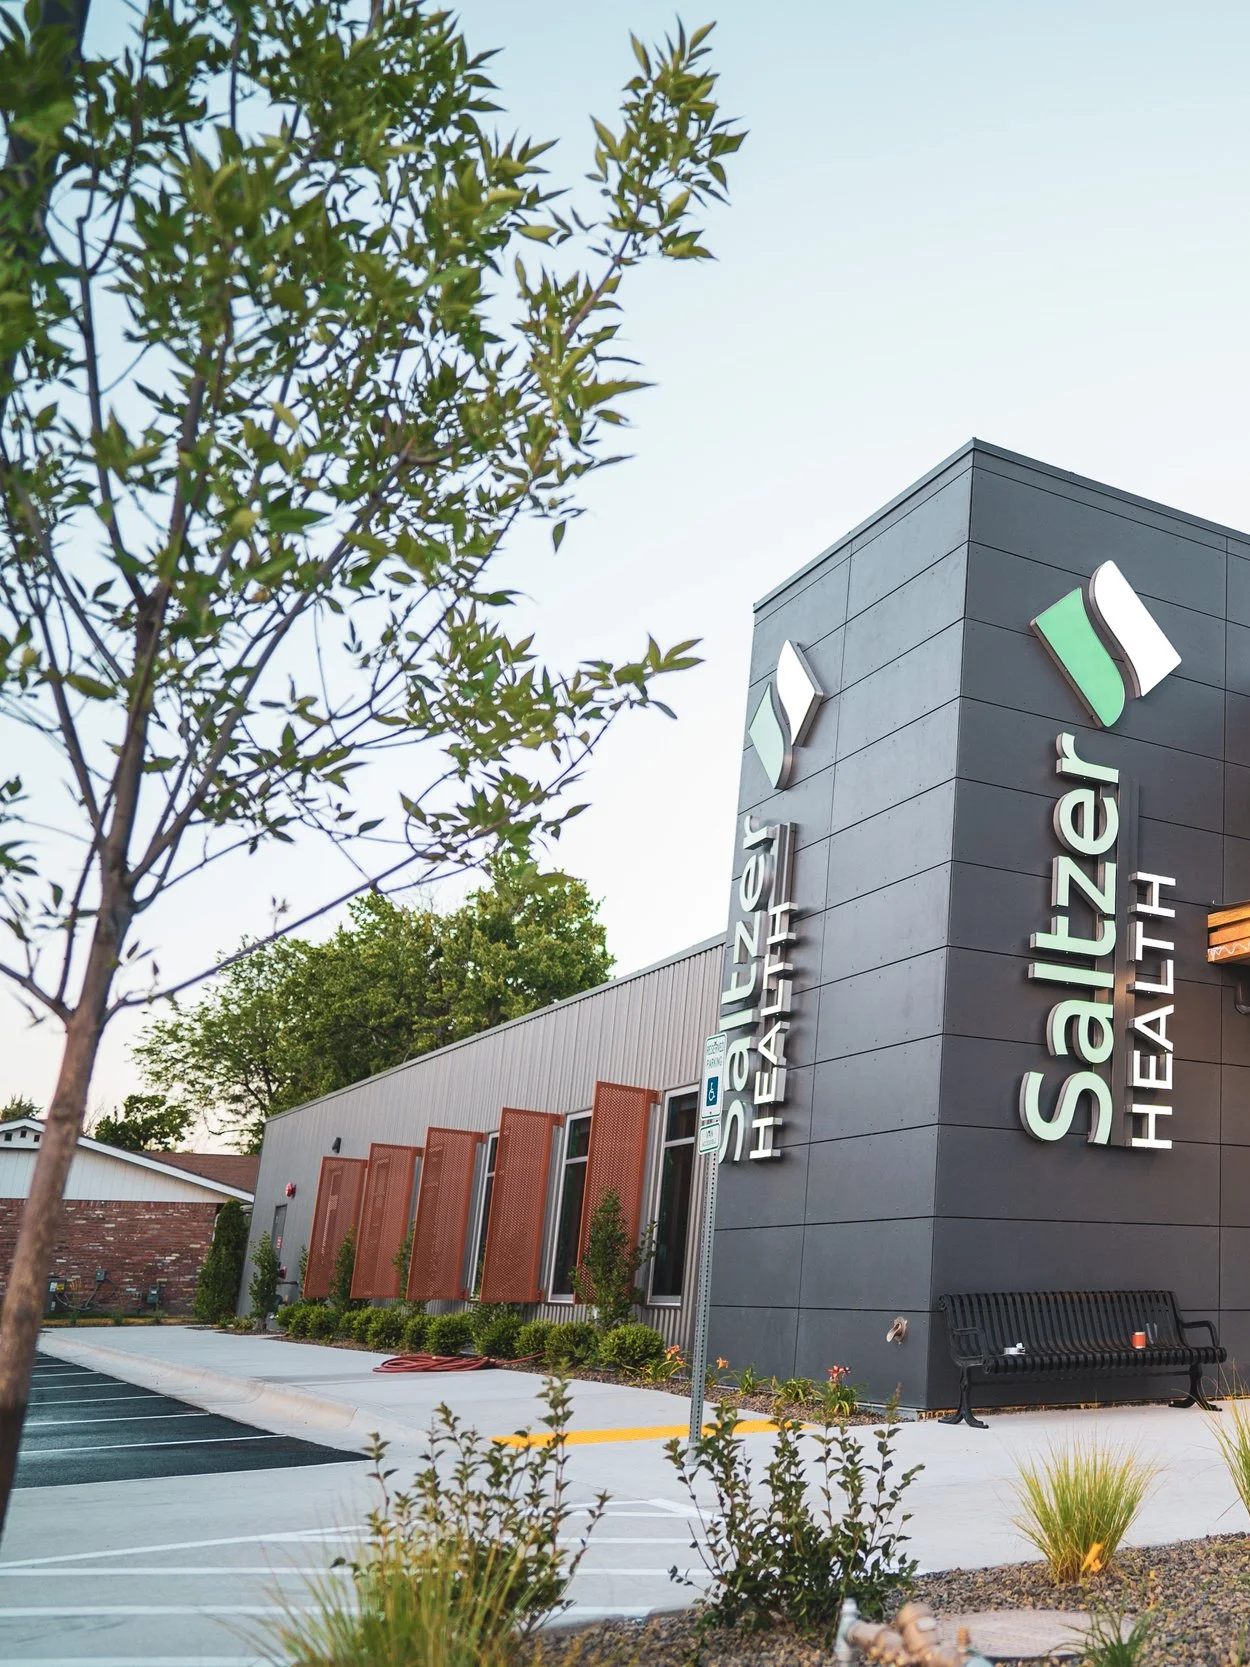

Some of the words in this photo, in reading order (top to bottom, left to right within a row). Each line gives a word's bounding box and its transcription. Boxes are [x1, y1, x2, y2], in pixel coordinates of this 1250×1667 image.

[718, 815, 775, 1164] Saltzer
[749, 902, 798, 1161] HEALTH
[1019, 732, 1120, 1145] Saltzer
[1125, 871, 1177, 1151] HEALTH
